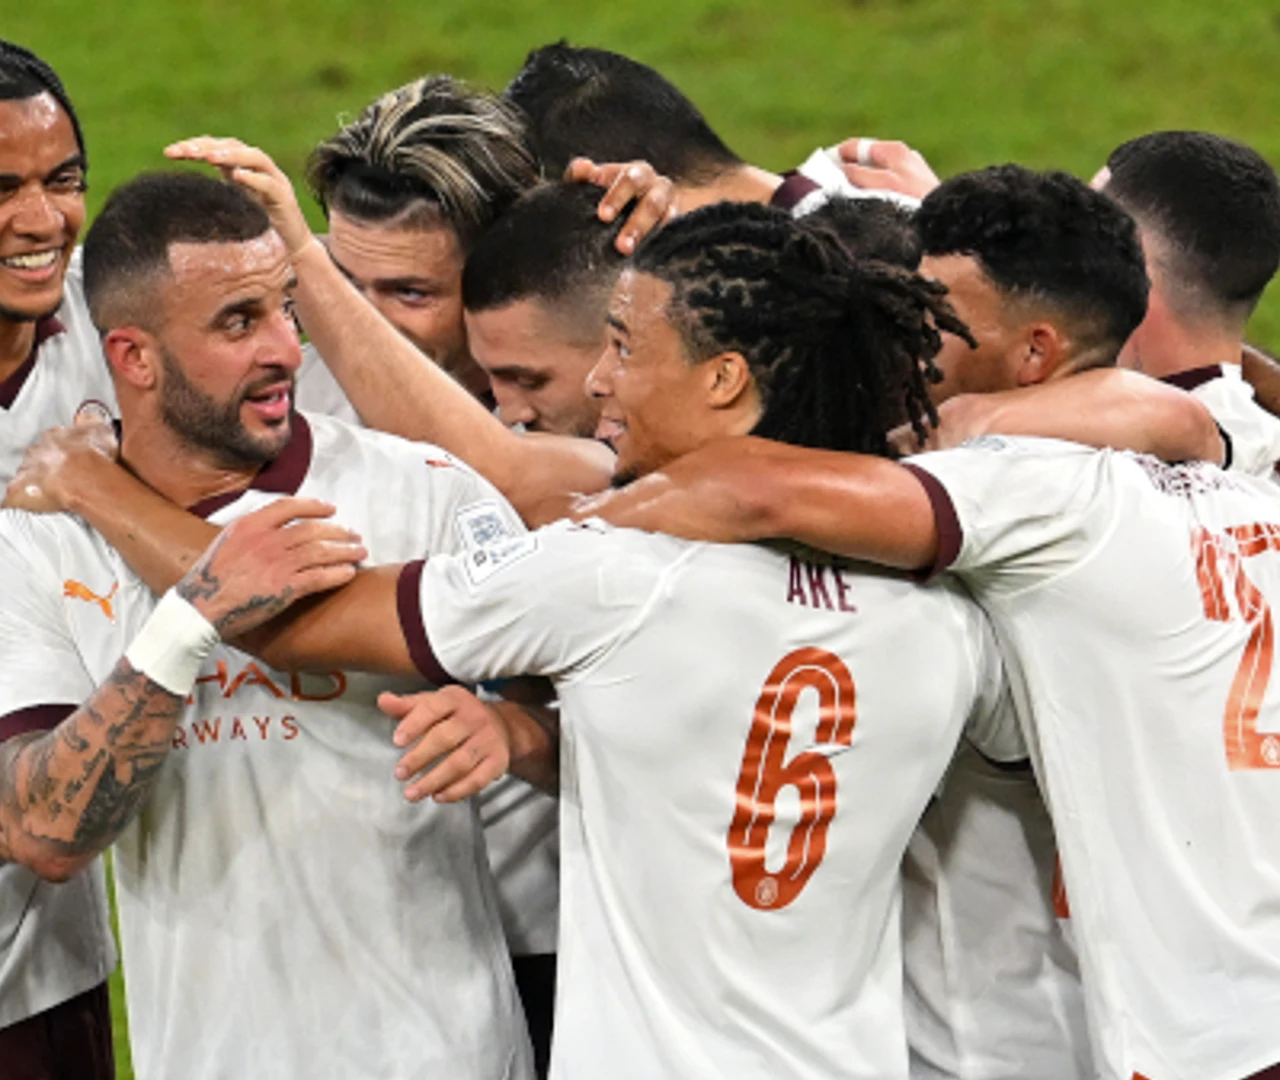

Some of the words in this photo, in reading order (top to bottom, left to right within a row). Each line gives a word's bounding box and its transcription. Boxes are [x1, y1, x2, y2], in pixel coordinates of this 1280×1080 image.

[187, 659, 346, 704] HAD
[172, 714, 299, 749] RWAYS
[727, 646, 857, 911] 6
